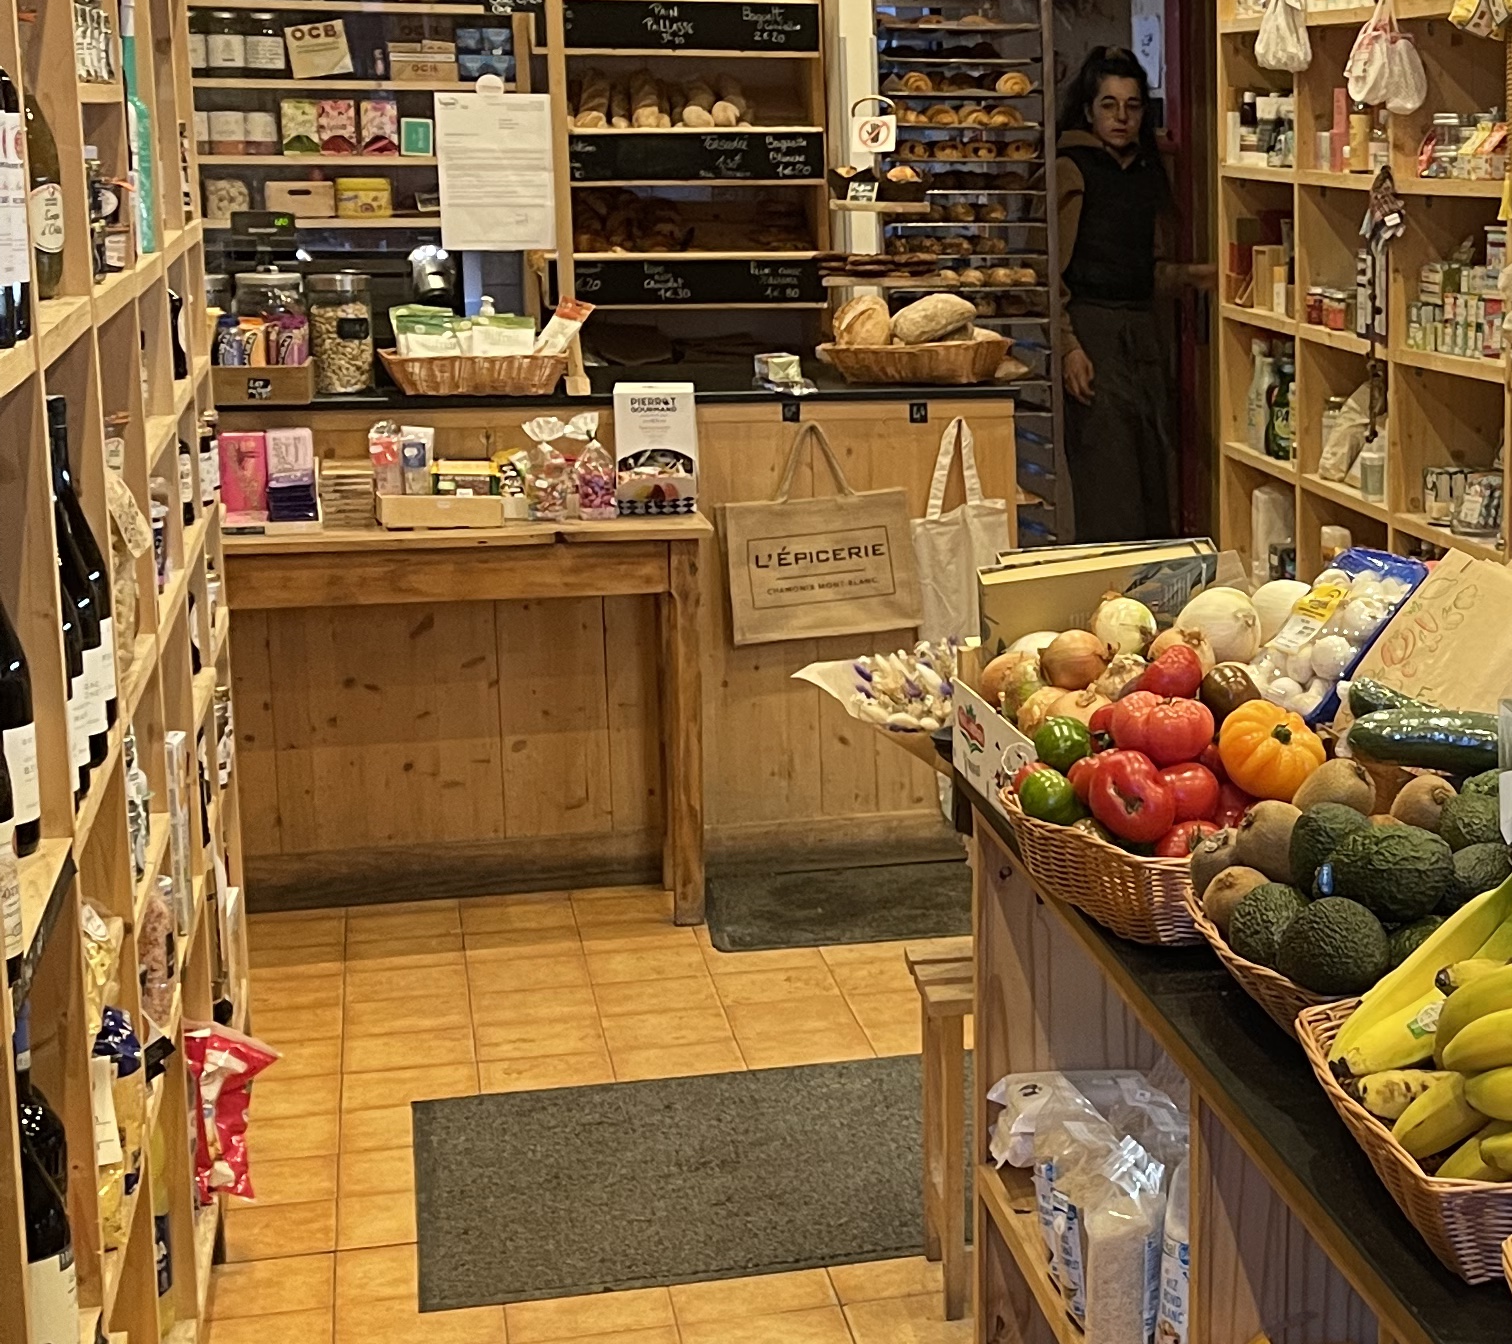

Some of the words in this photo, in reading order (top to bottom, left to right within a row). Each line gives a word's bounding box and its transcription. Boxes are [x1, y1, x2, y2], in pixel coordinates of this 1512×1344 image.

[291, 24, 338, 41] OCB
[630, 397, 676, 406] PIERROT
[754, 542, 886, 569] L'ÉPICERIE
